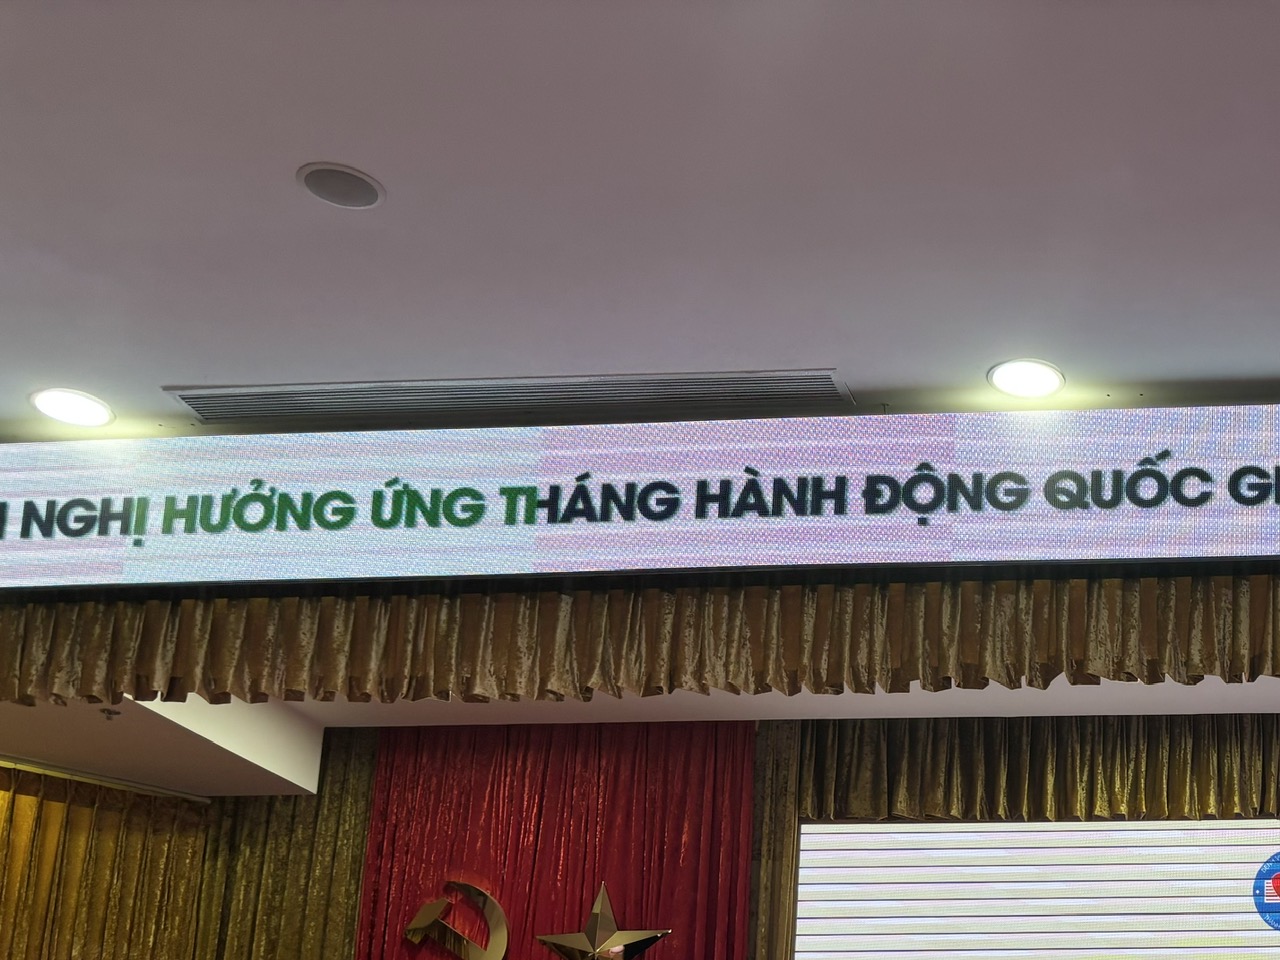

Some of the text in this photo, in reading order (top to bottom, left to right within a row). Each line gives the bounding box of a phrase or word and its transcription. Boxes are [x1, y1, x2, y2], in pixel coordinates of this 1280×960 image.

[20, 499, 147, 547] NGHỊ
[162, 478, 355, 534] HƯỞNG
[370, 477, 486, 531] ỨNG
[499, 469, 681, 527] THÁNG
[695, 466, 848, 520] HÀNH
[862, 461, 1031, 526] ĐỘNG
[1043, 449, 1213, 511] QUỐC
